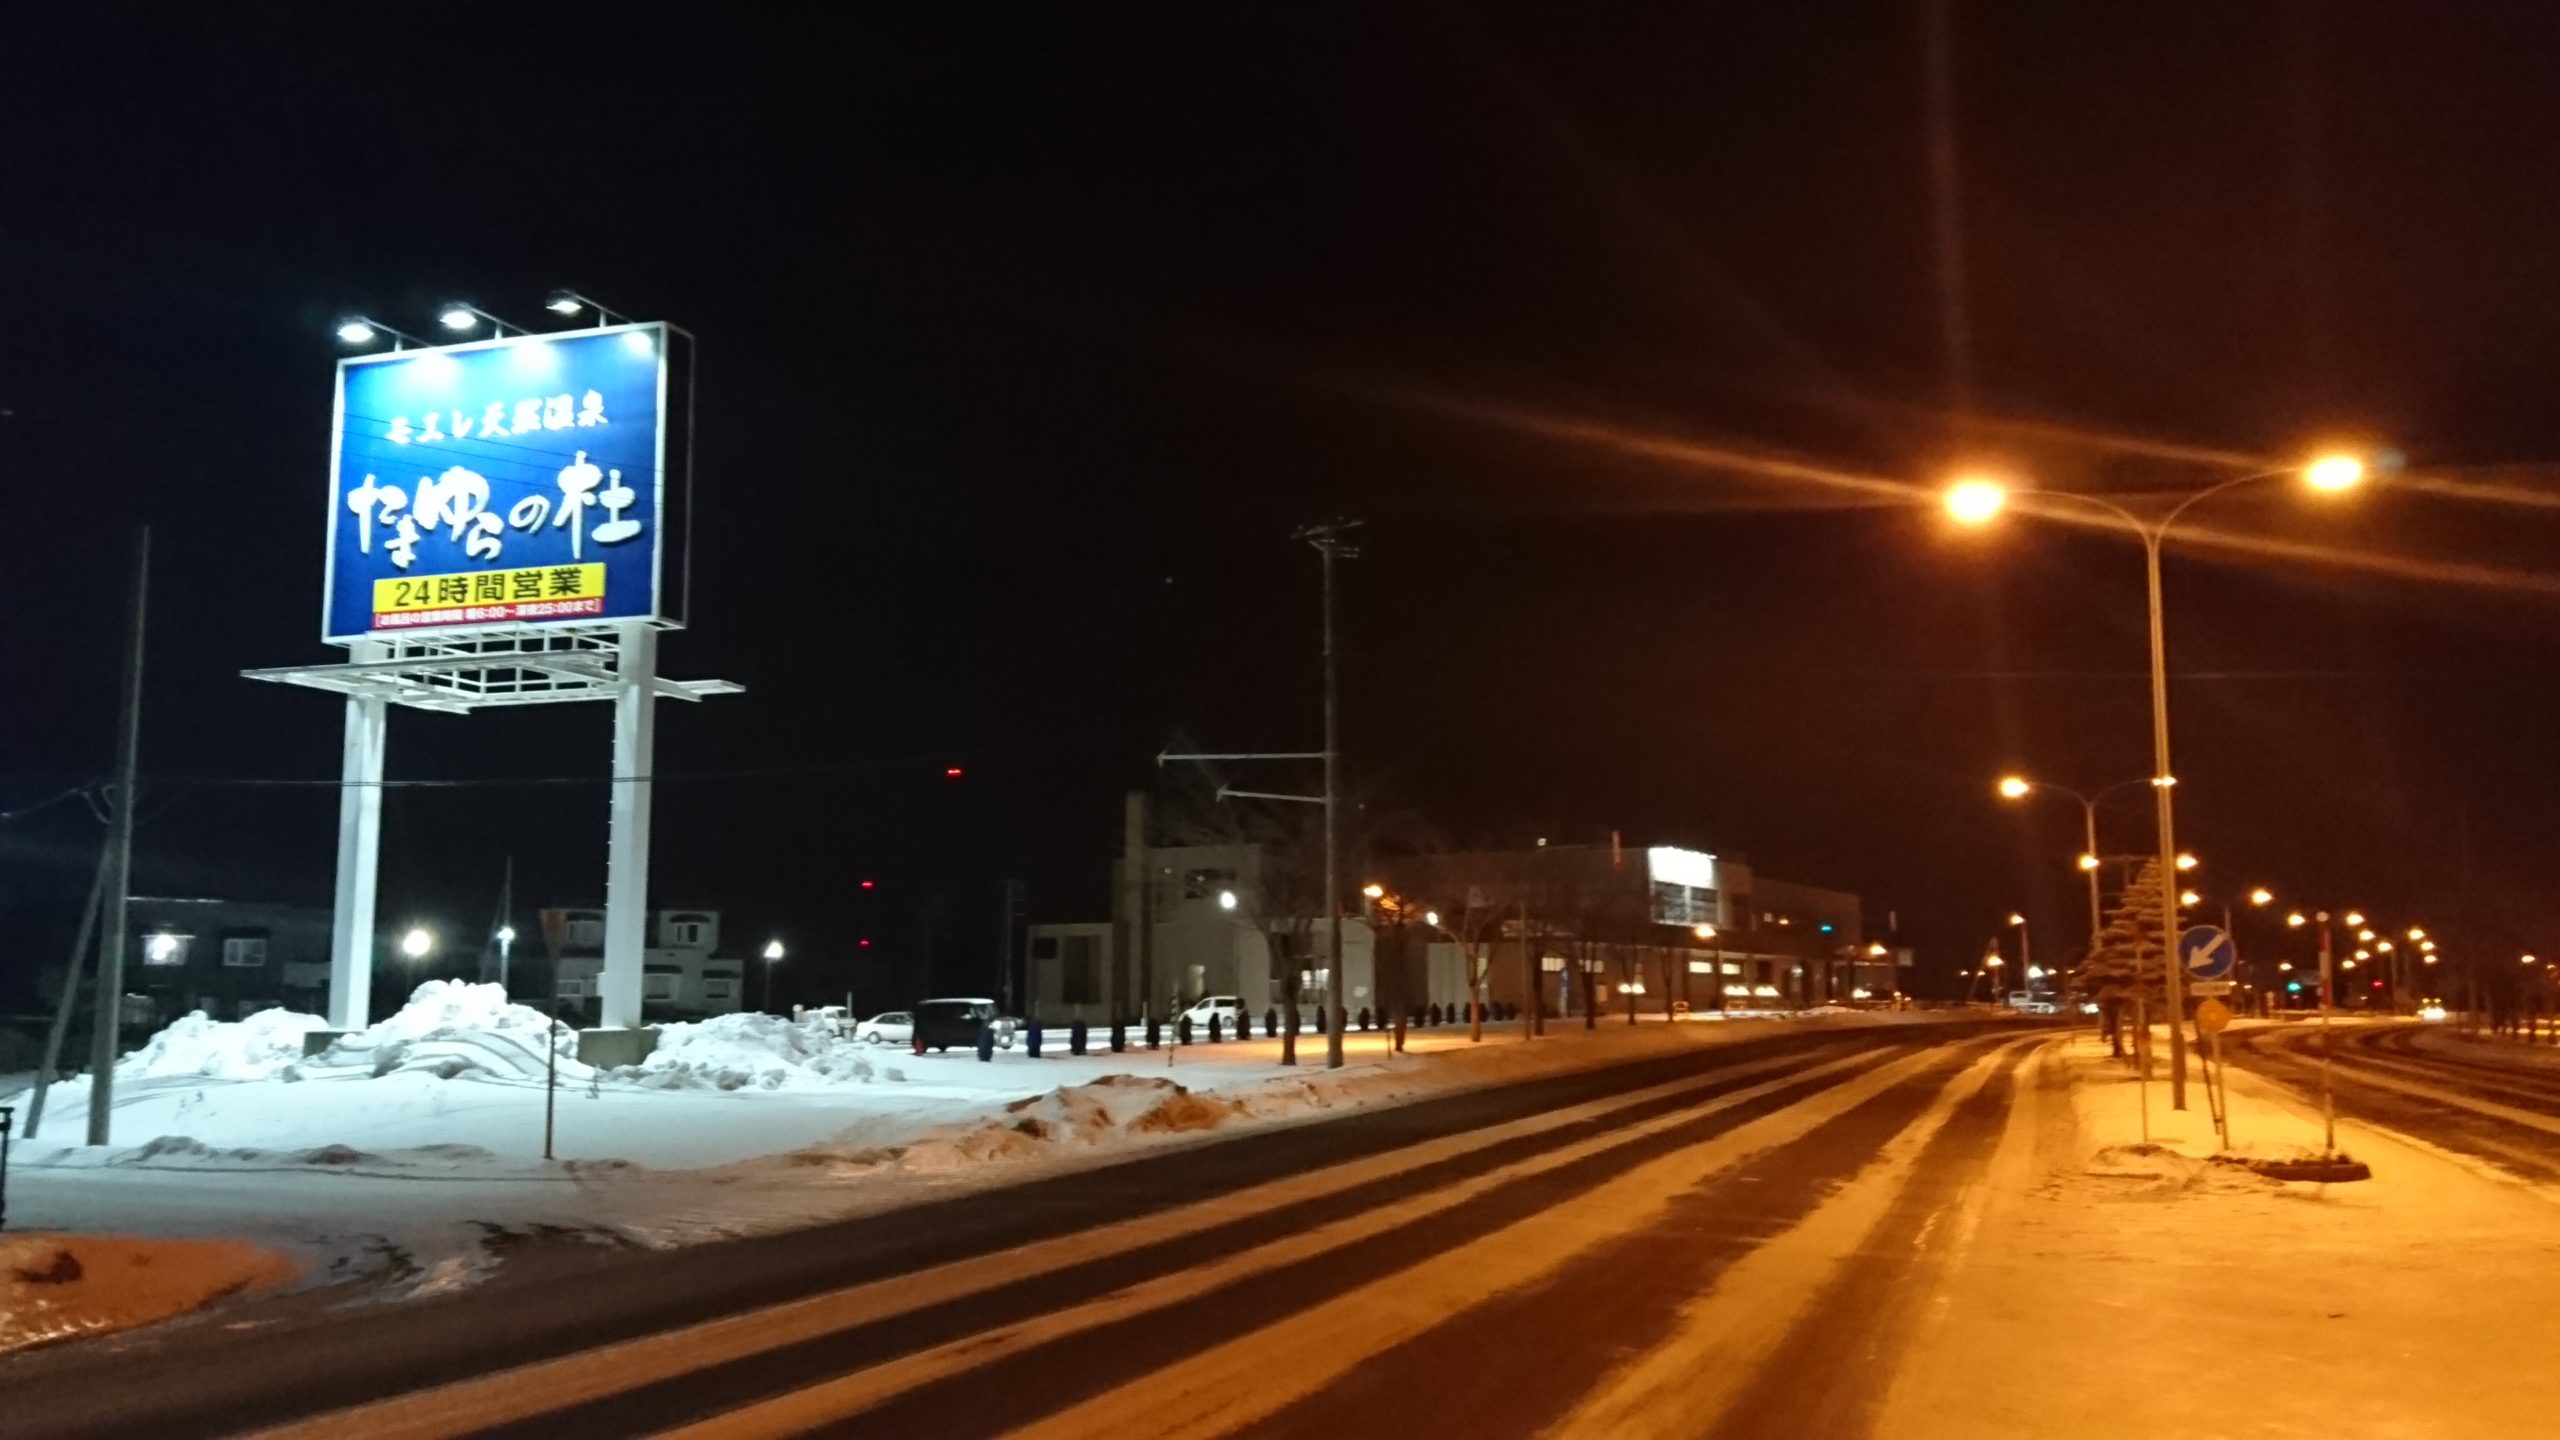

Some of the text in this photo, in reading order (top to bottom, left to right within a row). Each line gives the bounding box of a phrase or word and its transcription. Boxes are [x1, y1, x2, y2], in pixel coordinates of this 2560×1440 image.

[348, 450, 643, 568] たまゆらの杜
[394, 567, 582, 607] 24時間営業
